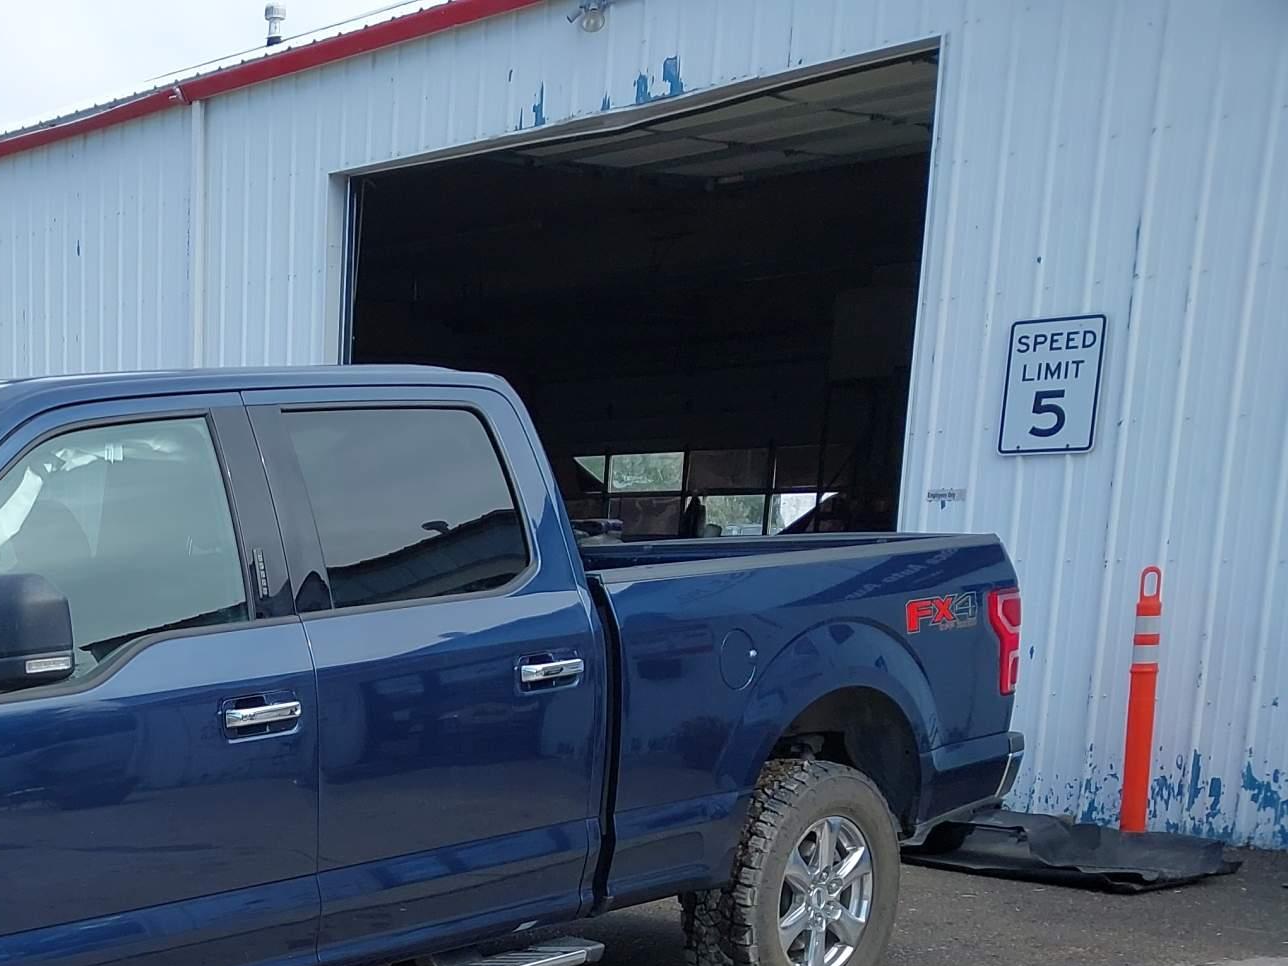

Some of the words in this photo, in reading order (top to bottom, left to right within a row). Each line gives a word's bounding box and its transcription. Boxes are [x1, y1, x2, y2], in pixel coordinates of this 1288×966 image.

[1016, 330, 1097, 353] SPEED
[1022, 360, 1085, 382] LIMIT
[1028, 389, 1066, 437] 5
[906, 591, 977, 634] FX4
